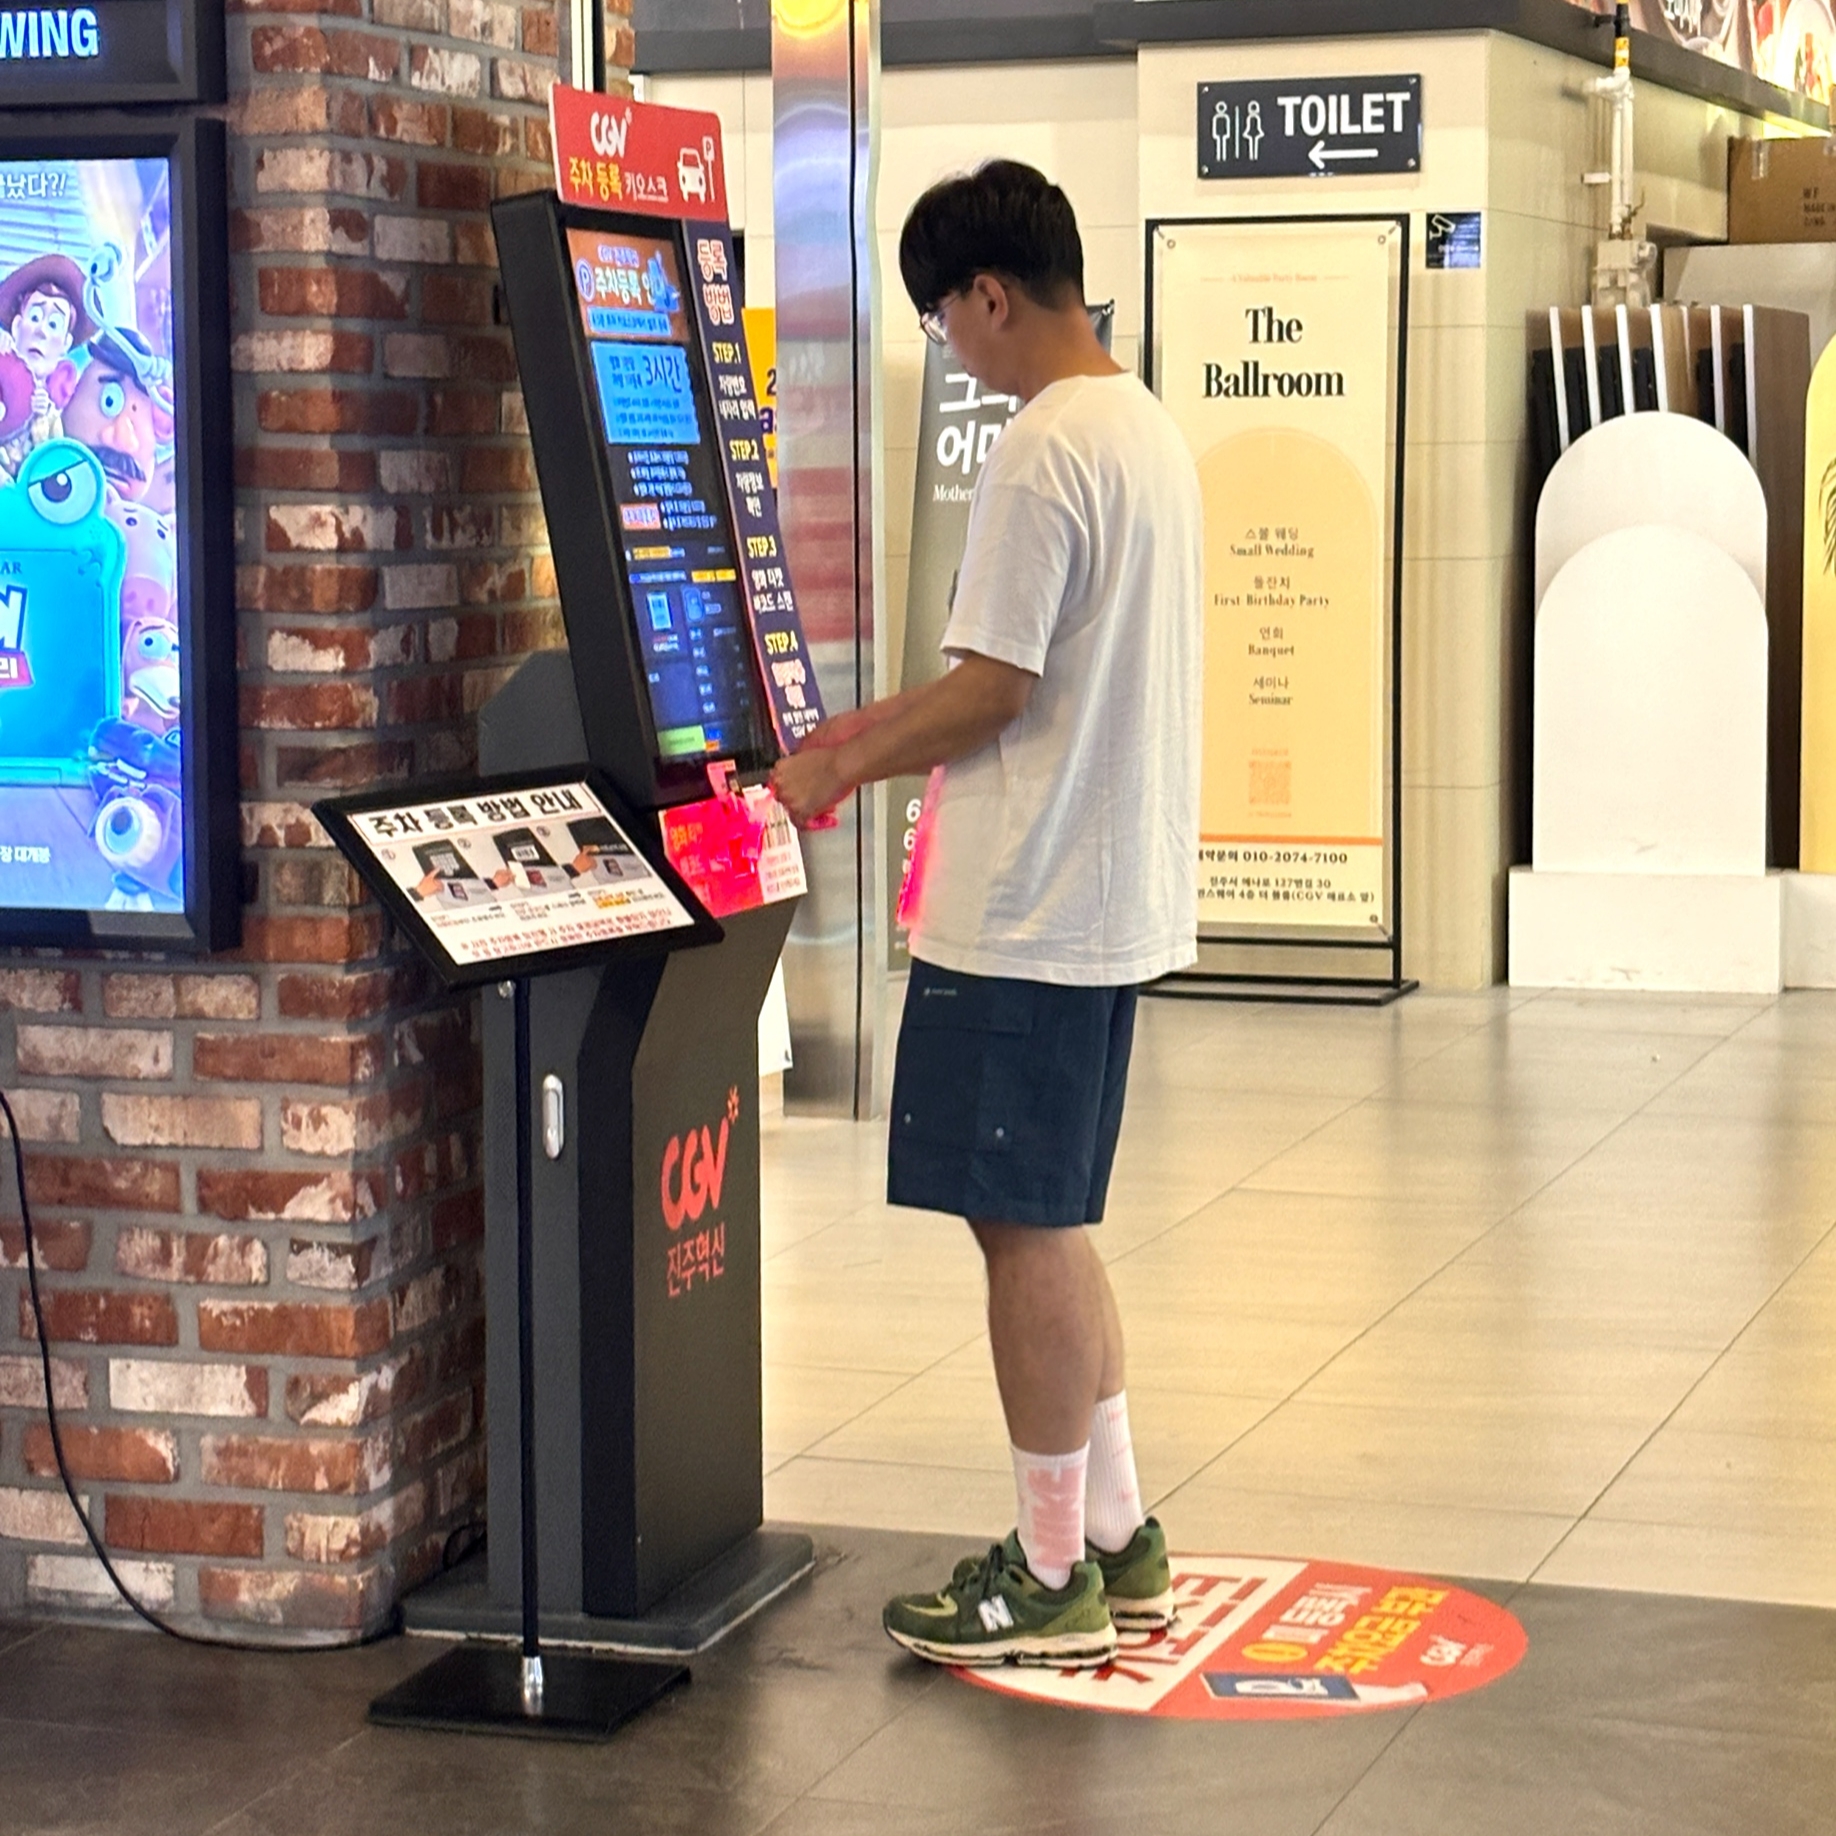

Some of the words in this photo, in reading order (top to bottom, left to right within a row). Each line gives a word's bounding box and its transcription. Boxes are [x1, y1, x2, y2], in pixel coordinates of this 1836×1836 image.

[1277, 92, 1411, 137] TOILET
[590, 111, 628, 159] CGV
[0, 173, 66, 199] 났다?!
[569, 157, 593, 198] 주차
[596, 162, 623, 201] 등록
[625, 171, 669, 203] 키오스크
[1245, 306, 1303, 344] The
[1202, 360, 1346, 398] Ballroom
[1230, 543, 1262, 557] Small
[1265, 543, 1315, 559] Wedding
[1214, 593, 1240, 606] First
[1246, 593, 1296, 608] Birthday
[1299, 594, 1330, 609] Party
[1248, 644, 1295, 658] Banquet
[1249, 693, 1294, 706] Seminar
[369, 811, 424, 837] 주차
[423, 804, 478, 831] 등록
[477, 796, 531, 822] 방법
[530, 788, 583, 816] 안내
[1243, 851, 1348, 864] 010-2074-7100
[1316, 879, 1332, 890] 30
[661, 1116, 730, 1231] CGV
[667, 1221, 725, 1298] 진주혁신
[978, 1594, 1014, 1633] N
